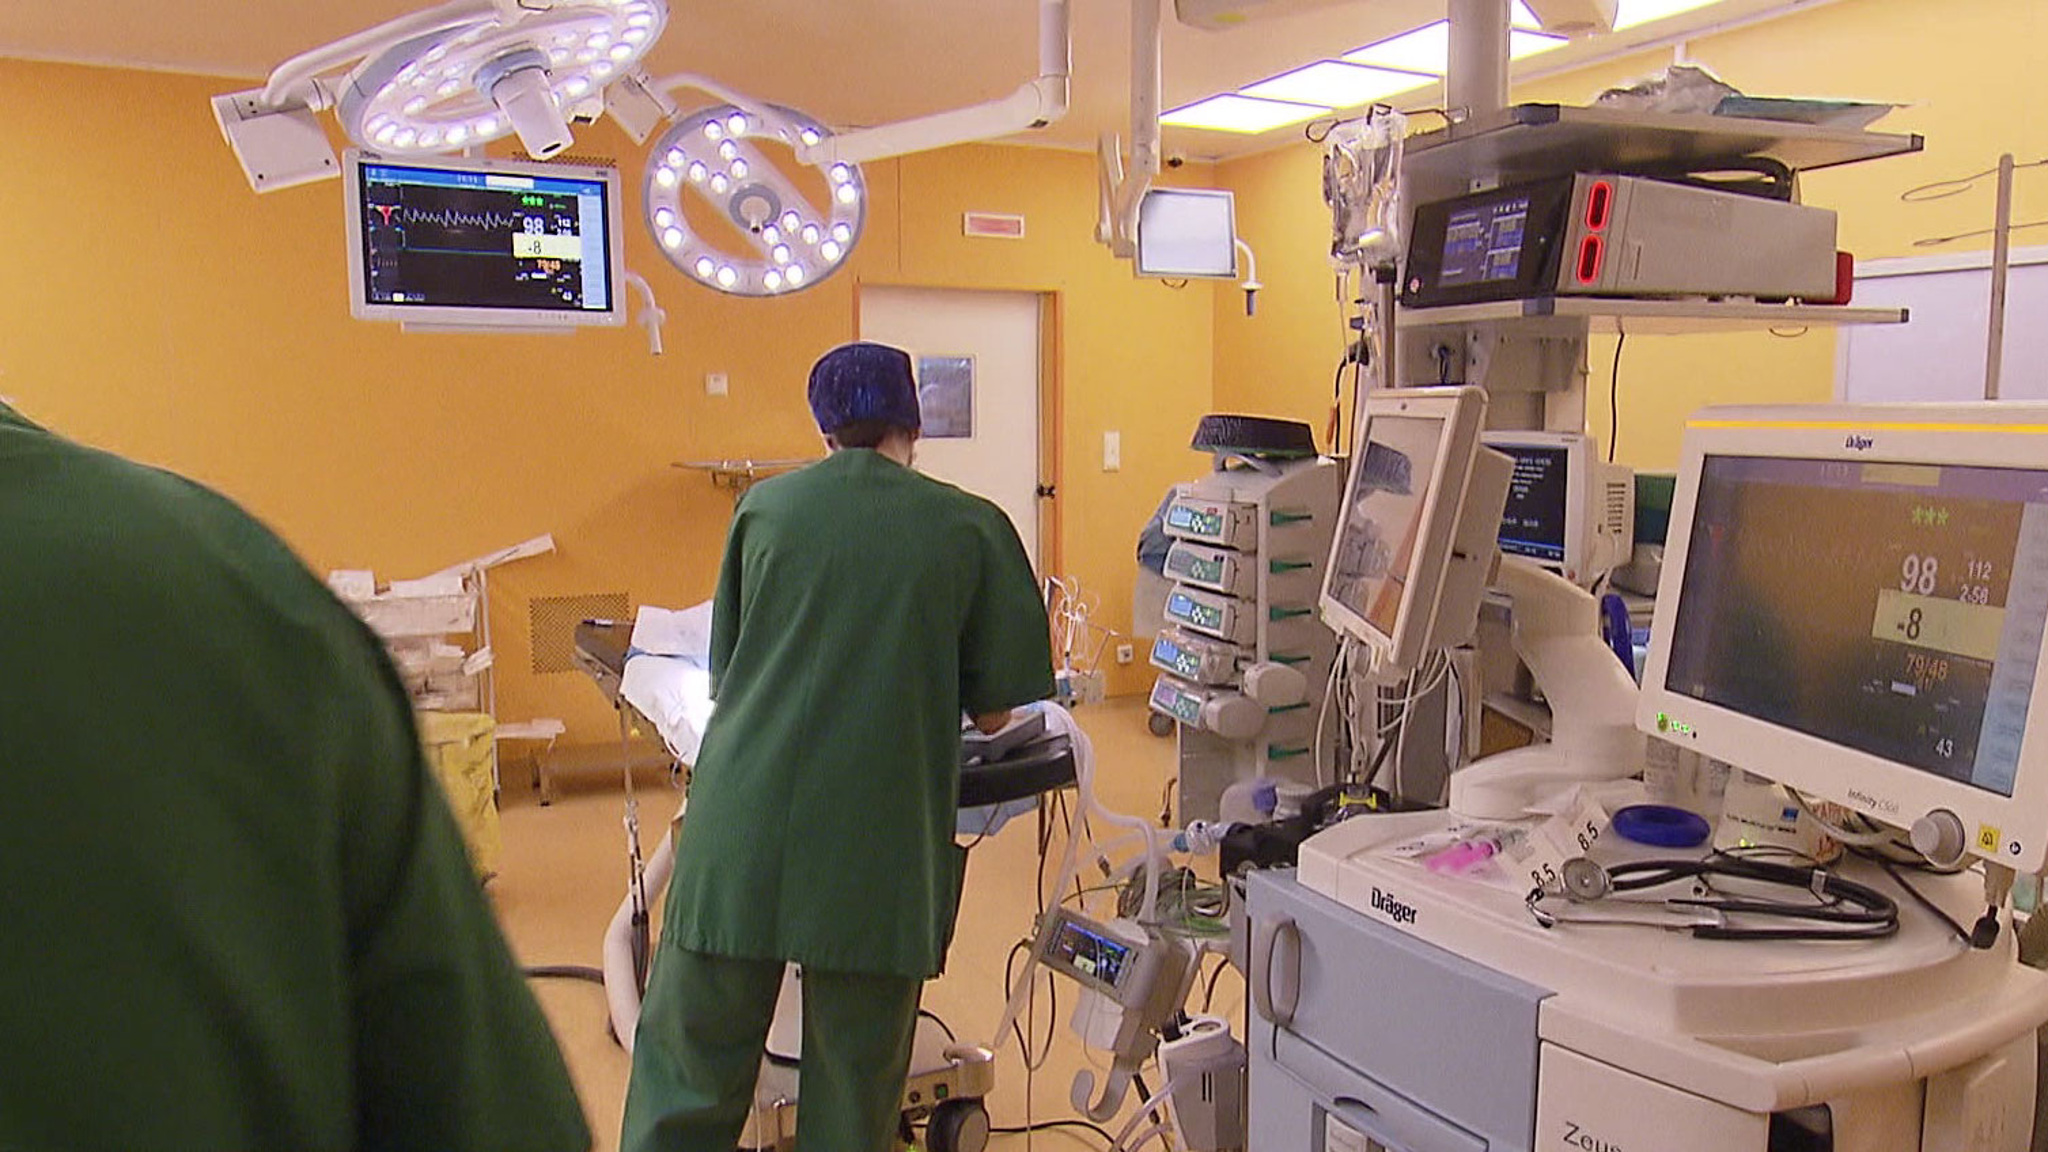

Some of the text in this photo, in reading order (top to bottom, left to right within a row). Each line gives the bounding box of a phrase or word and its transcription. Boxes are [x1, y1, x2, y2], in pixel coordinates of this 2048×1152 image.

[523, 216, 544, 234] 98
[1901, 553, 1938, 595] 98
[1967, 560, 1992, 580] 112
[1897, 607, 1923, 640] -8
[1905, 653, 1948, 682] 79/48
[1935, 738, 1954, 758] 43
[1577, 820, 1599, 851] 8.5
[1531, 863, 1556, 889] 8.5
[1371, 886, 1417, 924] Dräger
